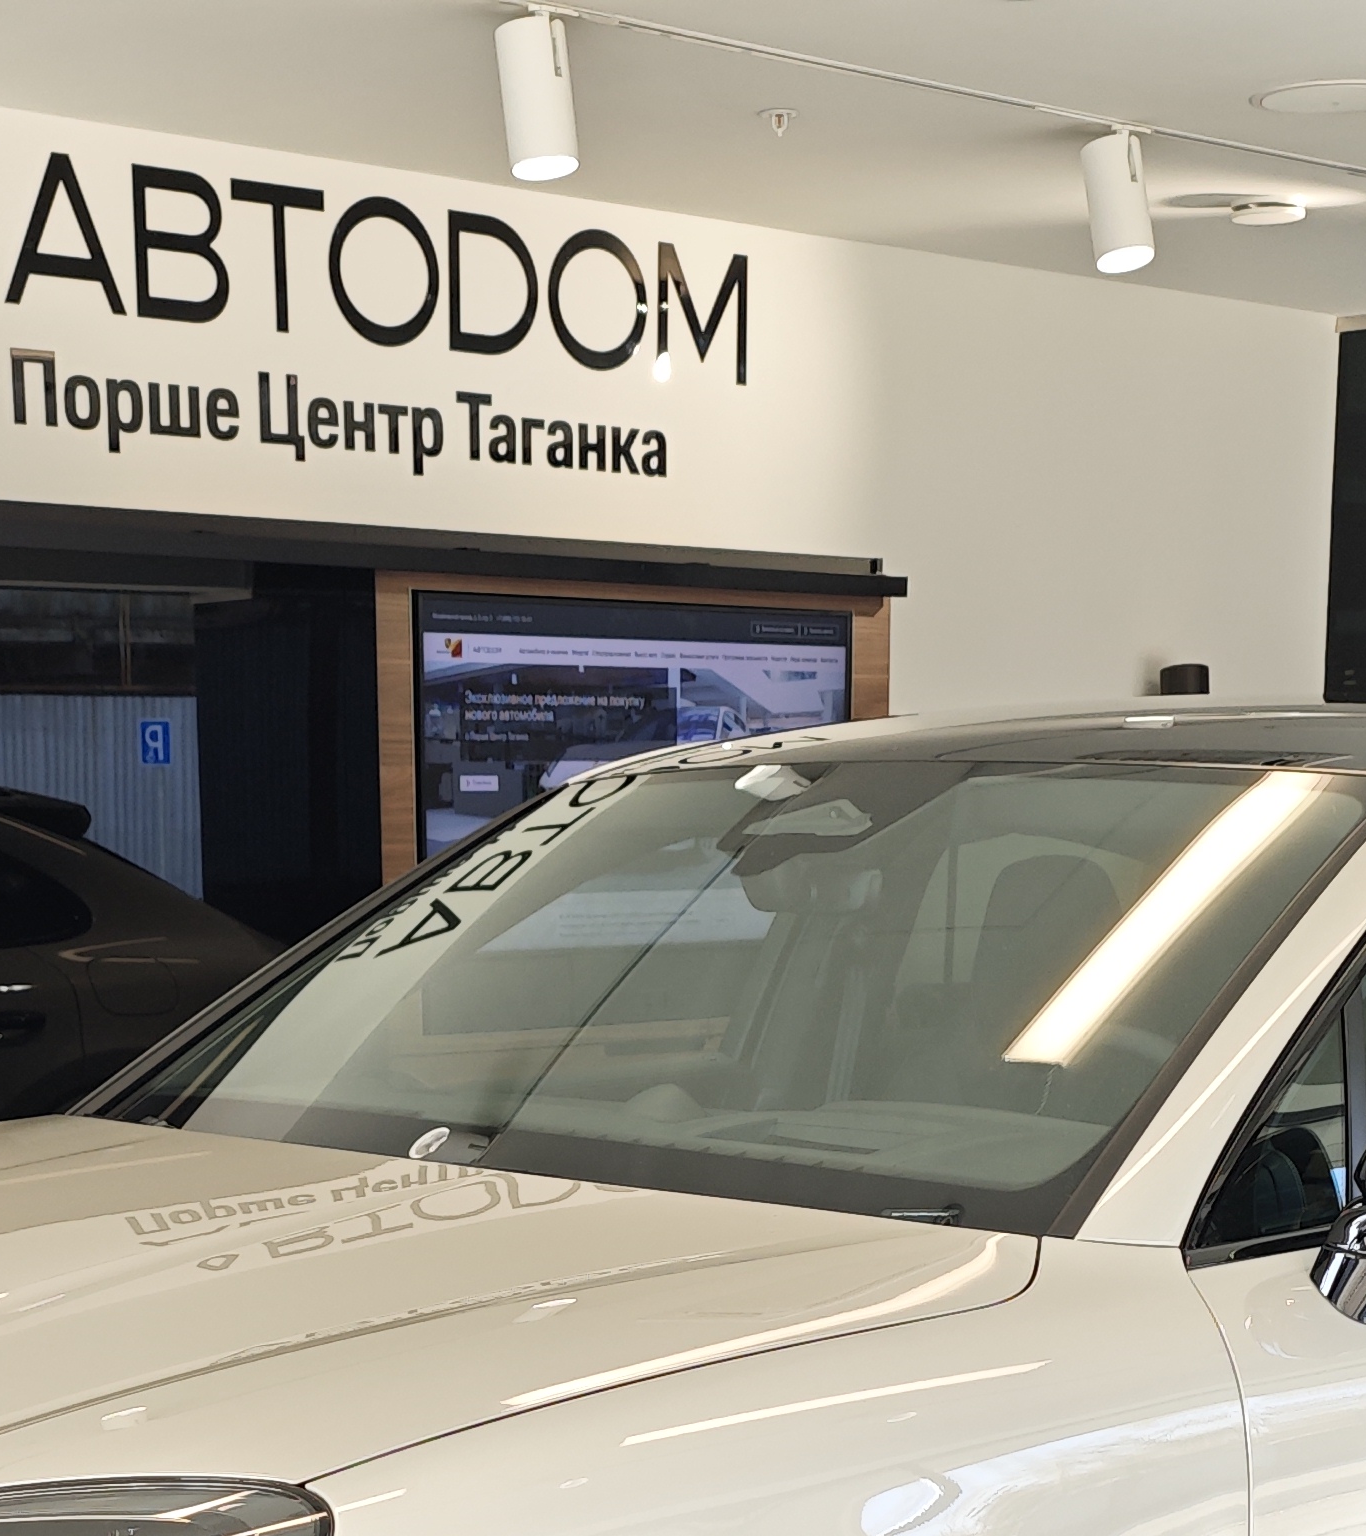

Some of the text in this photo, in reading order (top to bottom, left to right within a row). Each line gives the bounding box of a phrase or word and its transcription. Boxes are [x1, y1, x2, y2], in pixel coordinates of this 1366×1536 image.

[9, 347, 668, 478] Порше Центр Таганка
